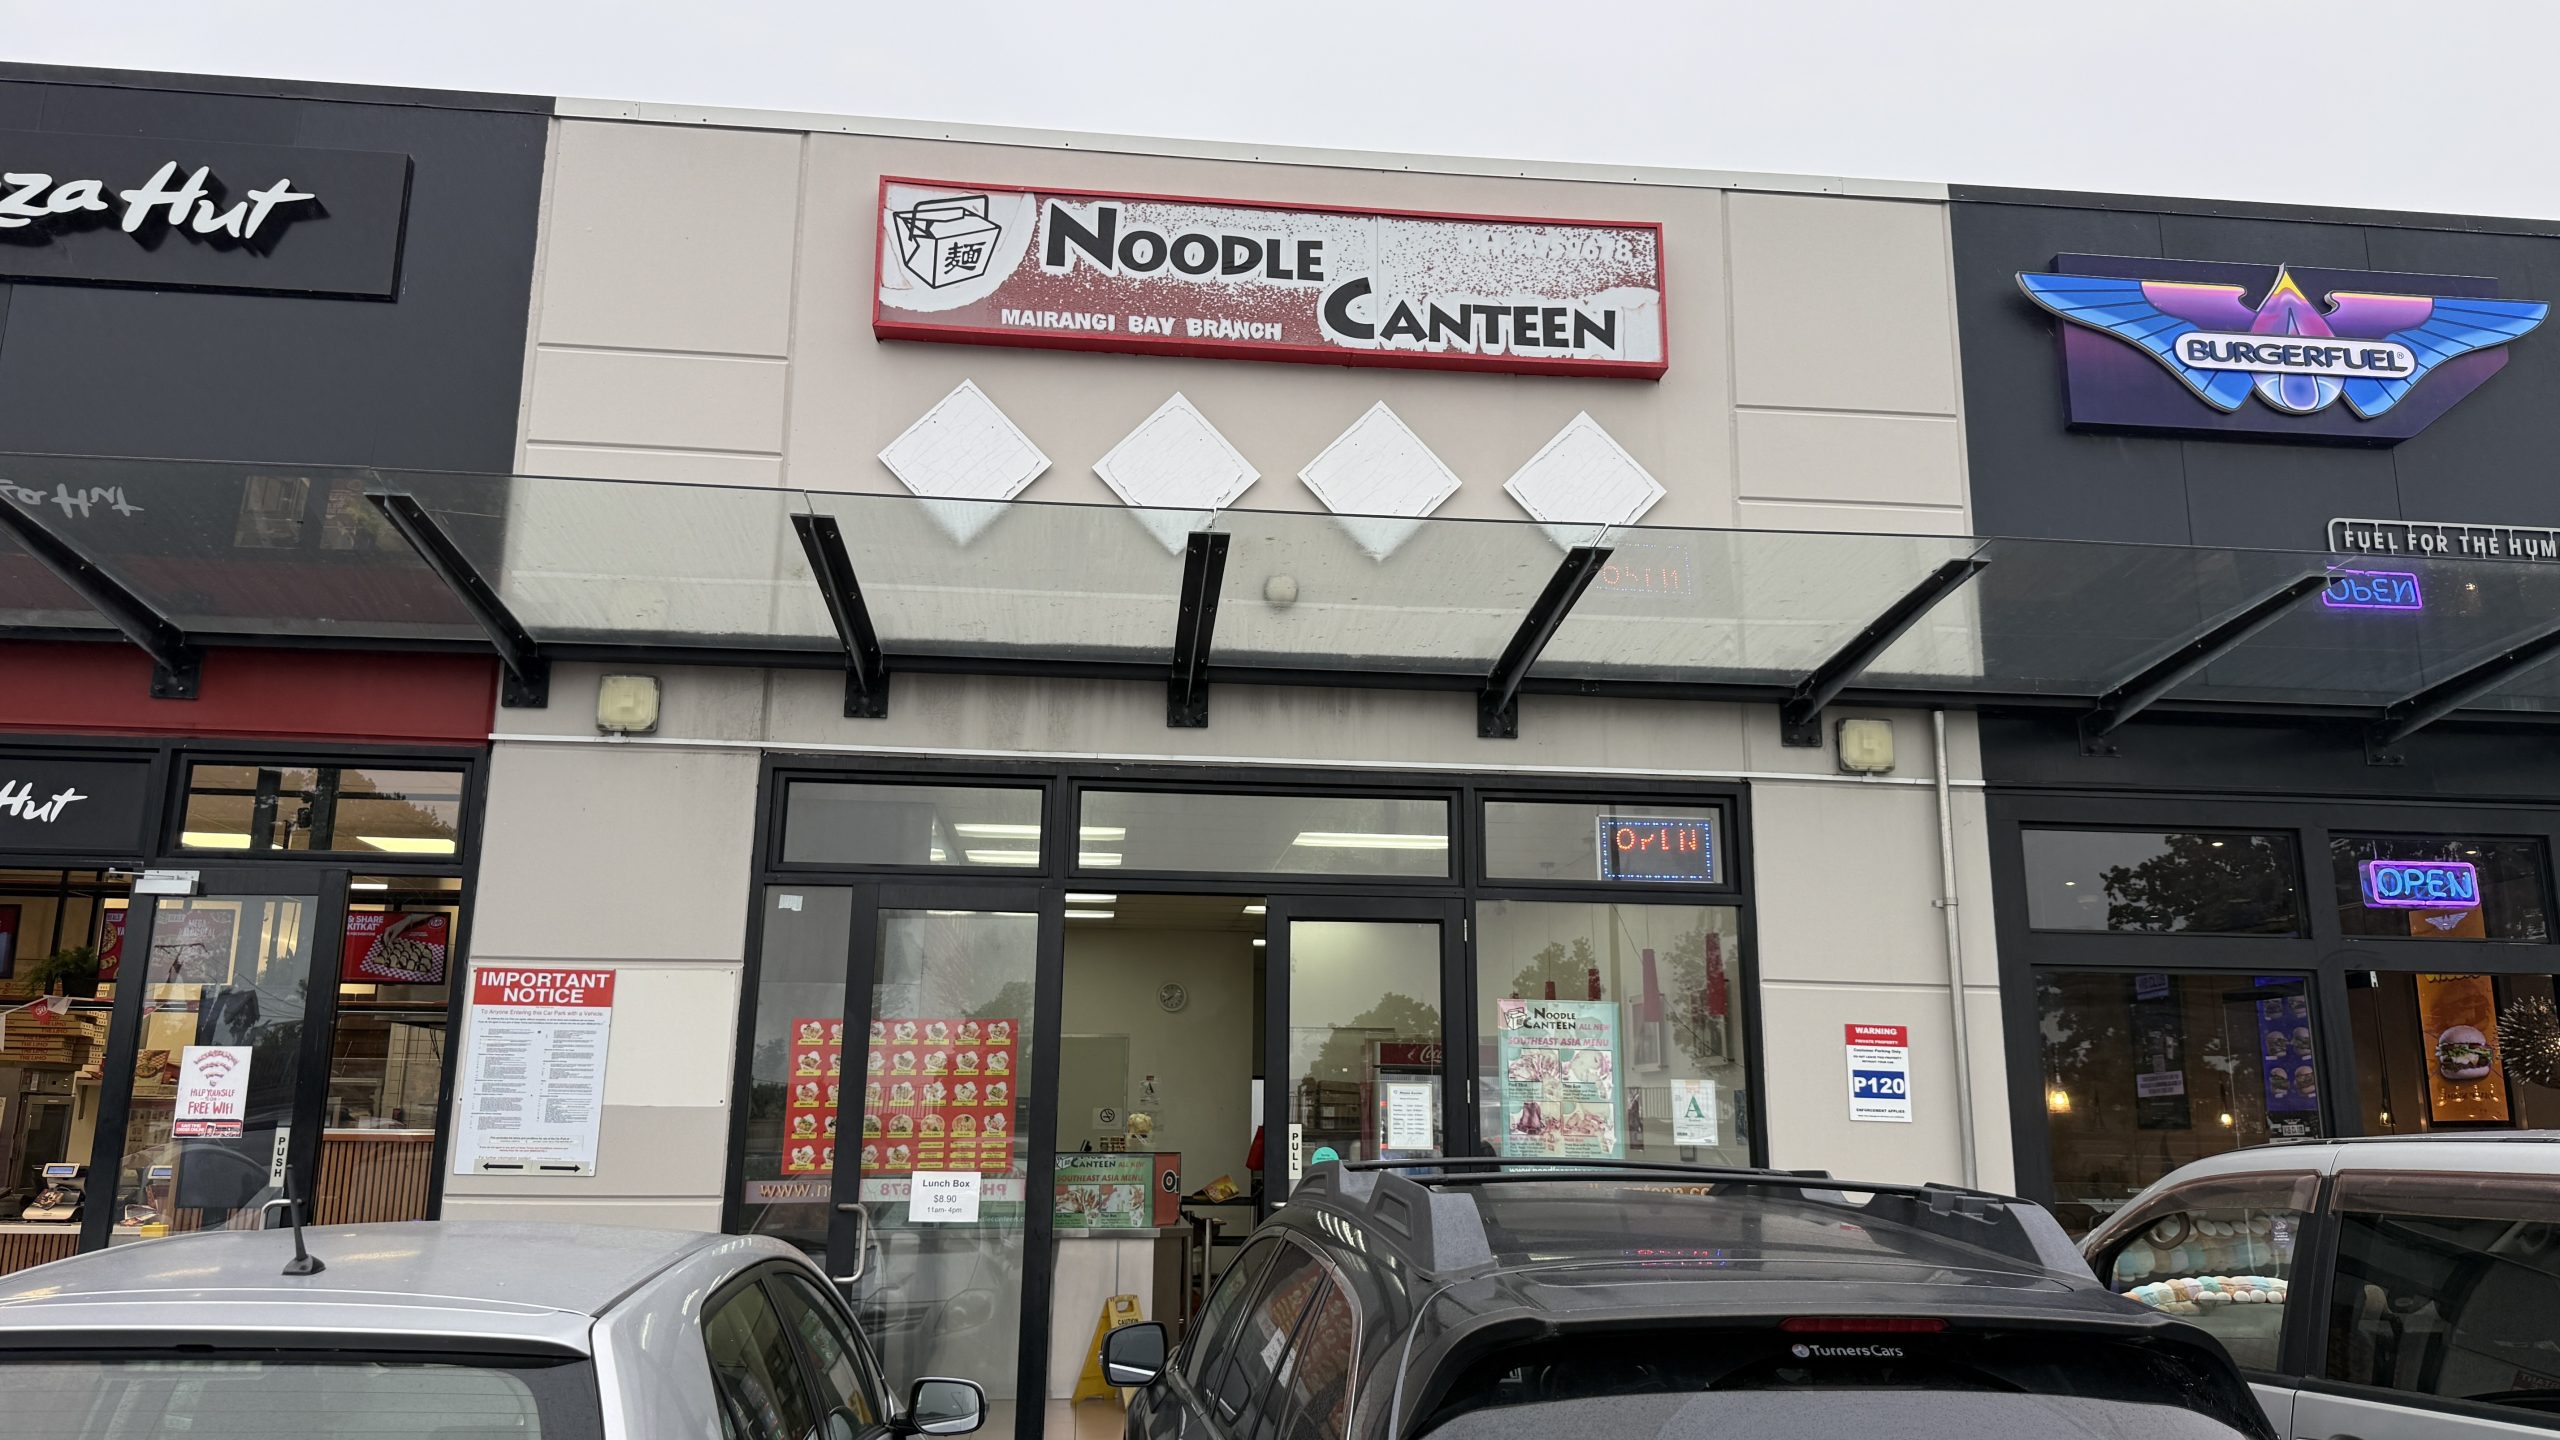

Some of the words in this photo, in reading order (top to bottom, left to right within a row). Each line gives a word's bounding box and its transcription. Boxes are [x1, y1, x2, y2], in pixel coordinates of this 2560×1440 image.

[120, 161, 315, 239] Hut
[1045, 202, 1325, 281] NOODLE
[1324, 277, 1616, 351] CANTEEN
[1002, 308, 1116, 332] MAIRANGI
[1185, 317, 1283, 341] BRANCH
[2344, 530, 2400, 551] FUEL
[2407, 533, 2449, 553] FOR
[2459, 535, 2500, 555] THE
[2509, 538, 2557, 558] HUM
[0, 780, 88, 823] Hut
[2377, 867, 2473, 898] OPEN
[481, 971, 611, 989] IMPORTANT
[503, 988, 585, 1004] NOTICE
[510, 1009, 532, 1017] Entering
[1534, 1007, 1577, 1020] NOODLE
[1523, 1017, 1577, 1030] CANTEEN
[1855, 1026, 1898, 1036] WARNING
[1508, 1036, 1559, 1046] SOUTHEAST
[1560, 1038, 1581, 1047] ASIA
[1583, 1038, 1609, 1047] MENU
[1853, 1077, 1905, 1095] P120
[187, 1101, 210, 1115] FREE
[1684, 1096, 1705, 1118] A
[273, 1136, 286, 1178] PUSH
[1291, 1132, 1299, 1171] PULL
[1071, 1158, 1116, 1168] CANTEEN
[922, 1179, 950, 1188] Lunch
[952, 1179, 970, 1188] Box
[1101, 1174, 1119, 1182] ASIA
[933, 1194, 957, 1203] $8.90
